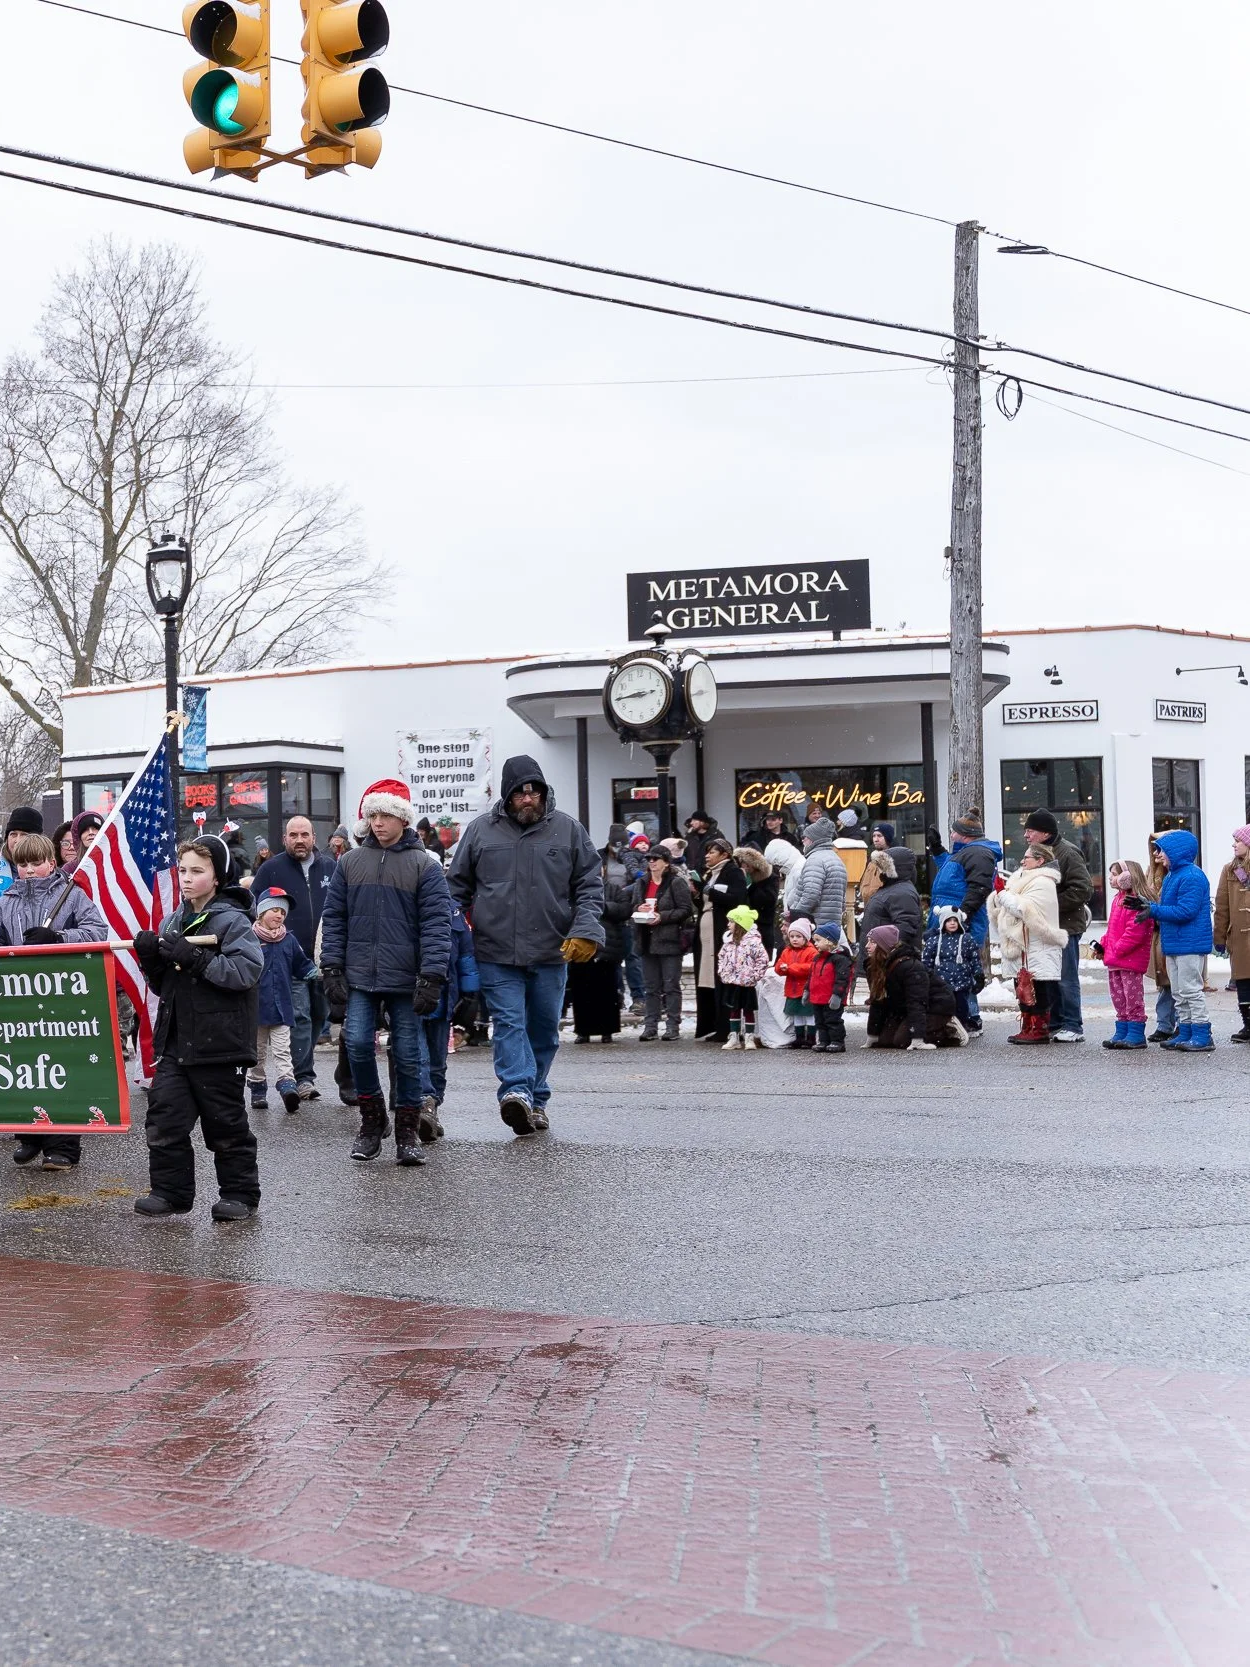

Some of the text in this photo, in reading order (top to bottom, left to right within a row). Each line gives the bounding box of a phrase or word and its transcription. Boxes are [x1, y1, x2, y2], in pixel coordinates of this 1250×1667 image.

[647, 570, 849, 601] METAMORA
[667, 601, 829, 630] GENERAL
[1008, 705, 1094, 720] ESPRESSO
[1159, 704, 1203, 718] PASTRIES
[418, 743, 469, 754] One stop
[417, 757, 473, 769] shopping
[411, 773, 475, 783] for everyone
[185, 784, 217, 796] BOOKS
[234, 781, 261, 793] GIFTS
[422, 788, 464, 799] on your
[739, 782, 806, 811] Coffee
[825, 784, 881, 808] Wine
[413, 802, 448, 813] "nice"
